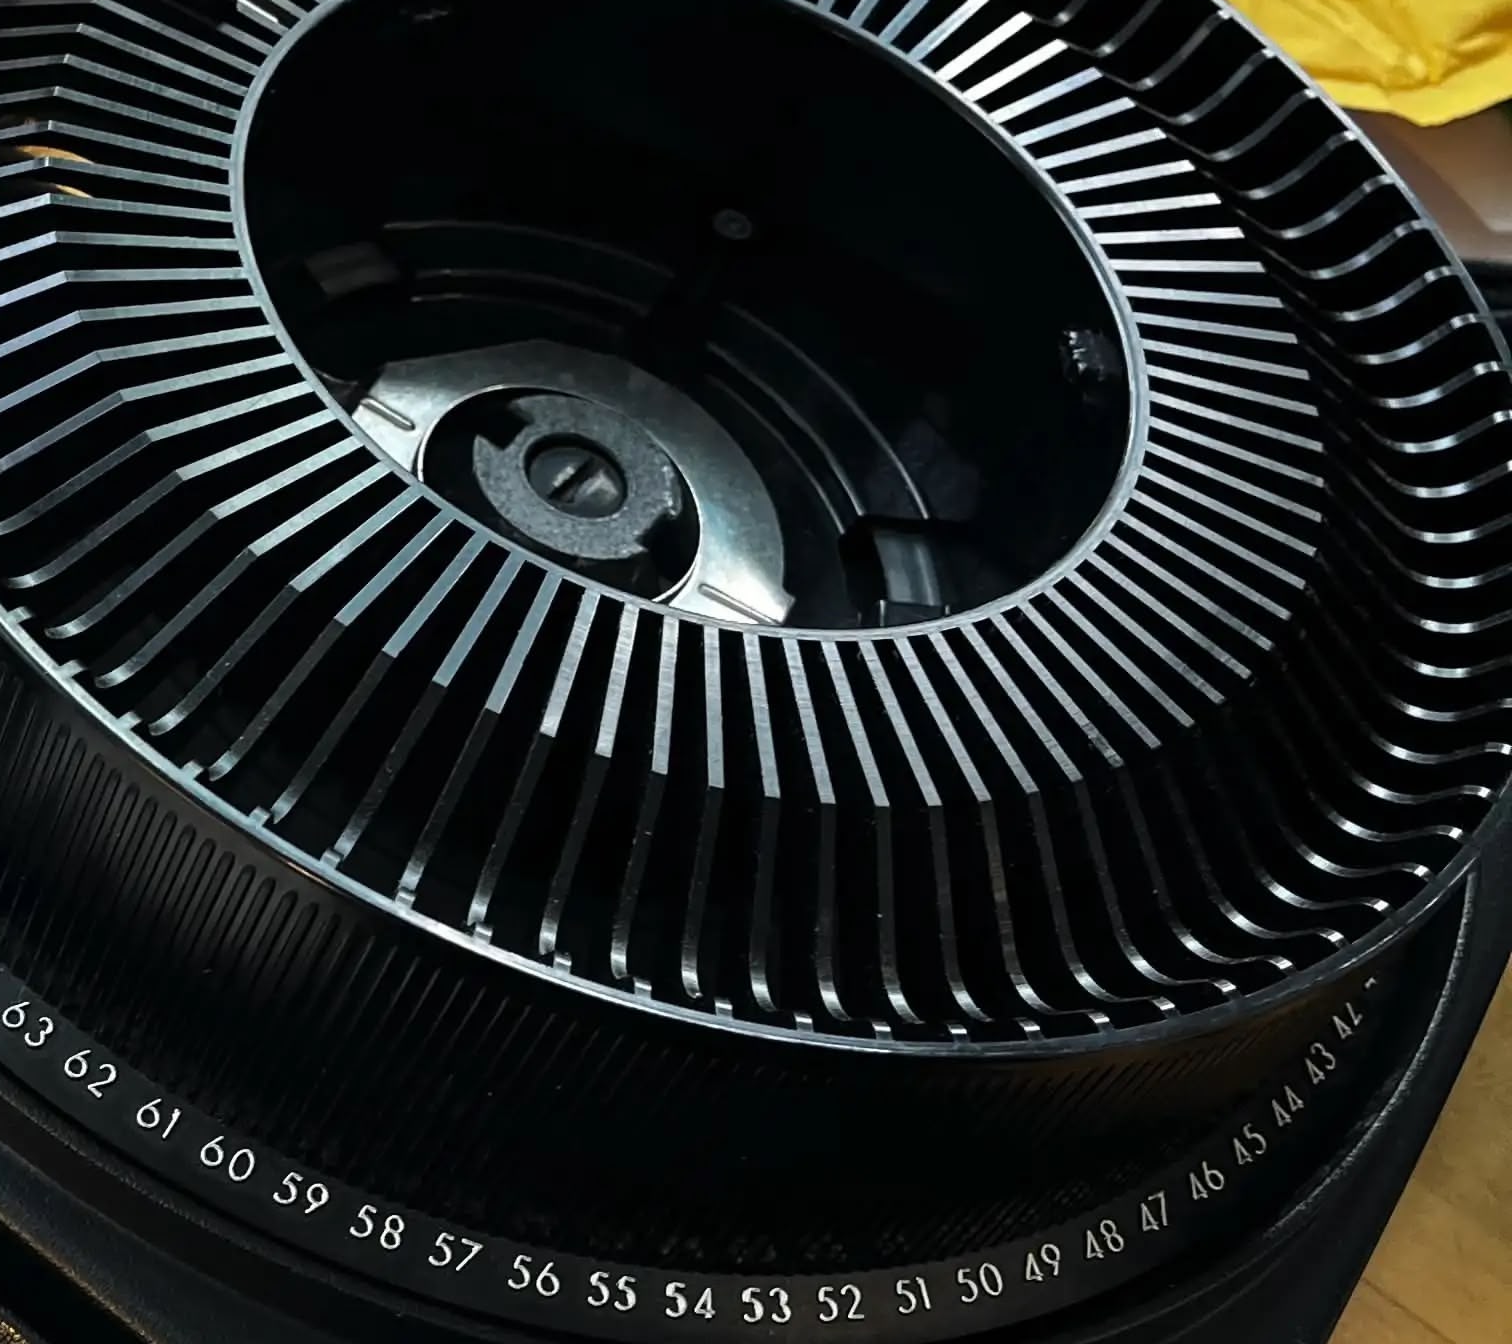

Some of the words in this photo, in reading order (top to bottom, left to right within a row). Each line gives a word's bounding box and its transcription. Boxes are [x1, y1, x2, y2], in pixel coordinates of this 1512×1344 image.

[2, 1002, 53, 1046] 63
[64, 1050, 116, 1098] 62
[137, 1098, 181, 1138] 61
[200, 1136, 255, 1181] 60
[273, 1172, 329, 1213] 59
[349, 1205, 404, 1249] 58
[428, 1232, 483, 1271] 57
[508, 1255, 560, 1296] 56
[588, 1272, 636, 1311] 55
[666, 1282, 715, 1318] 54
[742, 1287, 791, 1323] 53
[818, 1284, 864, 1321] 52
[896, 1277, 931, 1313] 51
[958, 1263, 1003, 1302] 50
[1026, 1244, 1060, 1281] 49
[1087, 1220, 1124, 1258] 48
[1141, 1191, 1167, 1231] 47
[1190, 1161, 1224, 1200] 46
[1234, 1124, 1266, 1164] 45
[1272, 1086, 1304, 1126] 44
[1306, 1043, 1335, 1084] 43
